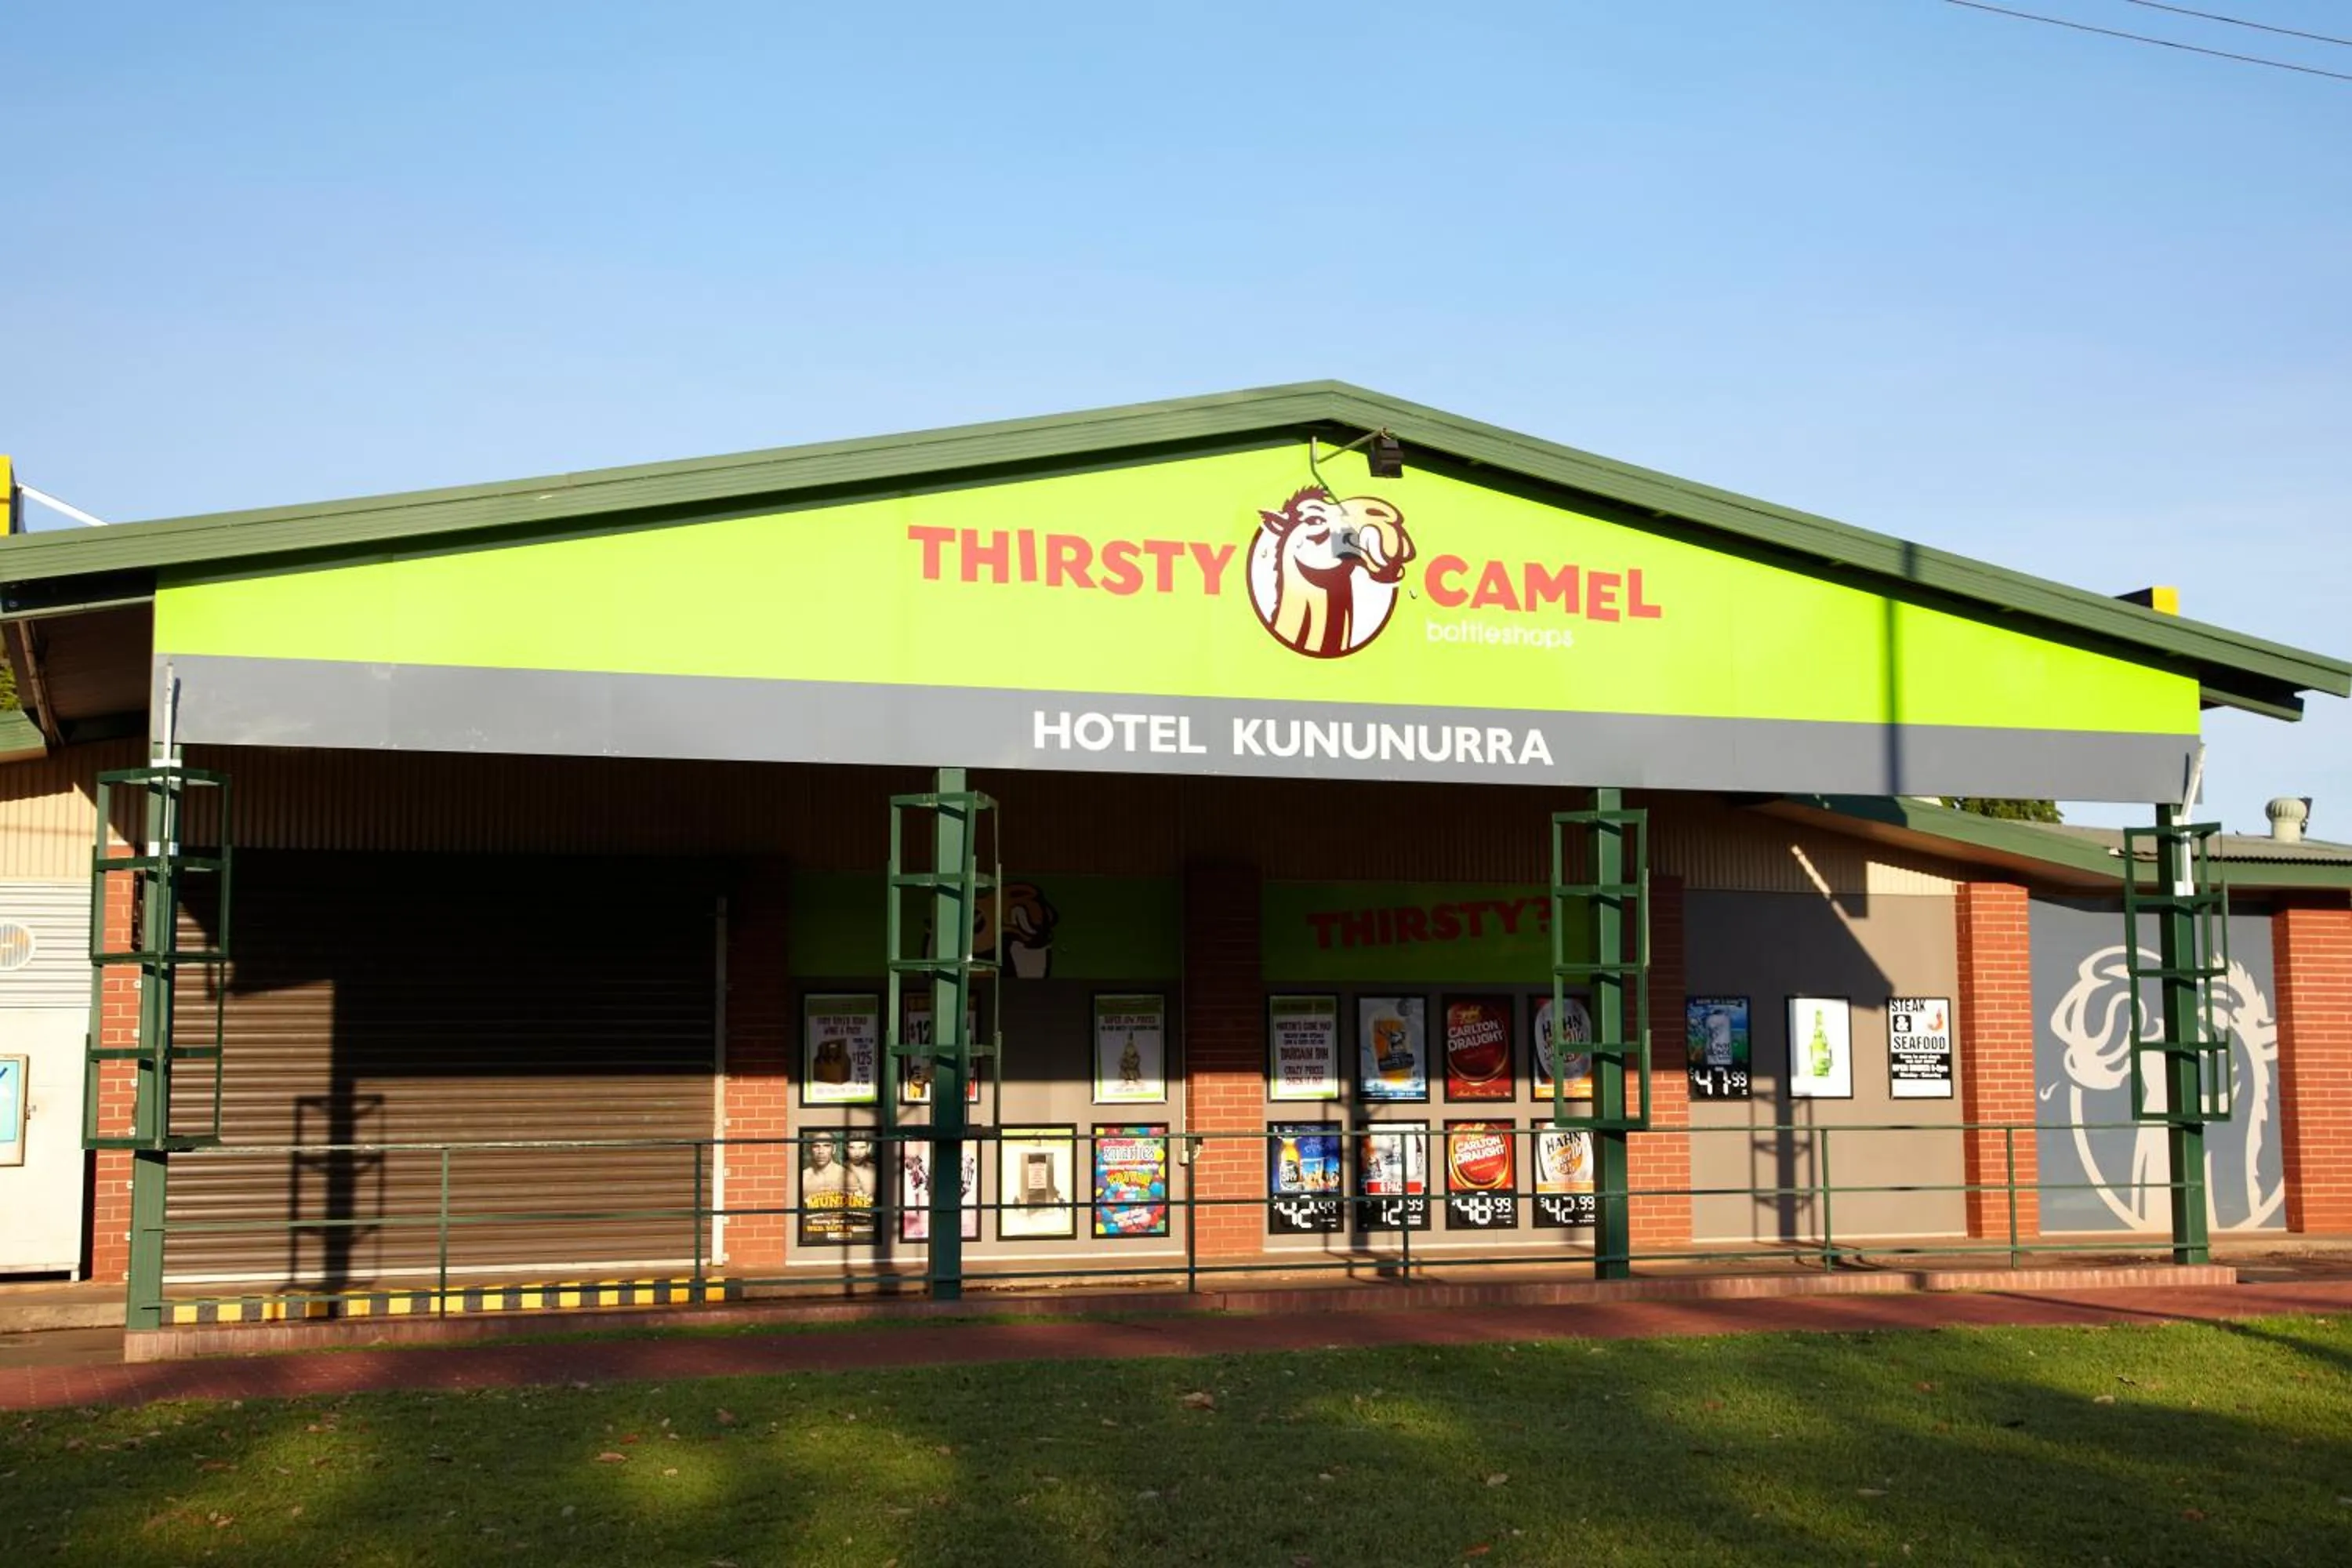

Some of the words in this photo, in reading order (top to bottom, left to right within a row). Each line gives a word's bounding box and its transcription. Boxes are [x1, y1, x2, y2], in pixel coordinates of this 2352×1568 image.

[907, 524, 1237, 596] THIRSTY
[1424, 554, 1662, 622] CAMEL
[1425, 619, 1575, 649] bottleshops
[1033, 710, 1207, 755] HOTEL
[1232, 717, 1555, 767] KUNUNURRA
[1305, 896, 1552, 950] THIRSTY?
[1891, 998, 1926, 1013] STEAK
[1448, 1018, 1499, 1038] CARLTON
[1448, 1030, 1504, 1051] DRAUGHT
[1893, 1036, 1946, 1050] SEAFOOD
[1455, 1134, 1501, 1152] CARLTON
[1545, 1131, 1581, 1155] HAHN
[1455, 1144, 1505, 1165] DRAUGHT
